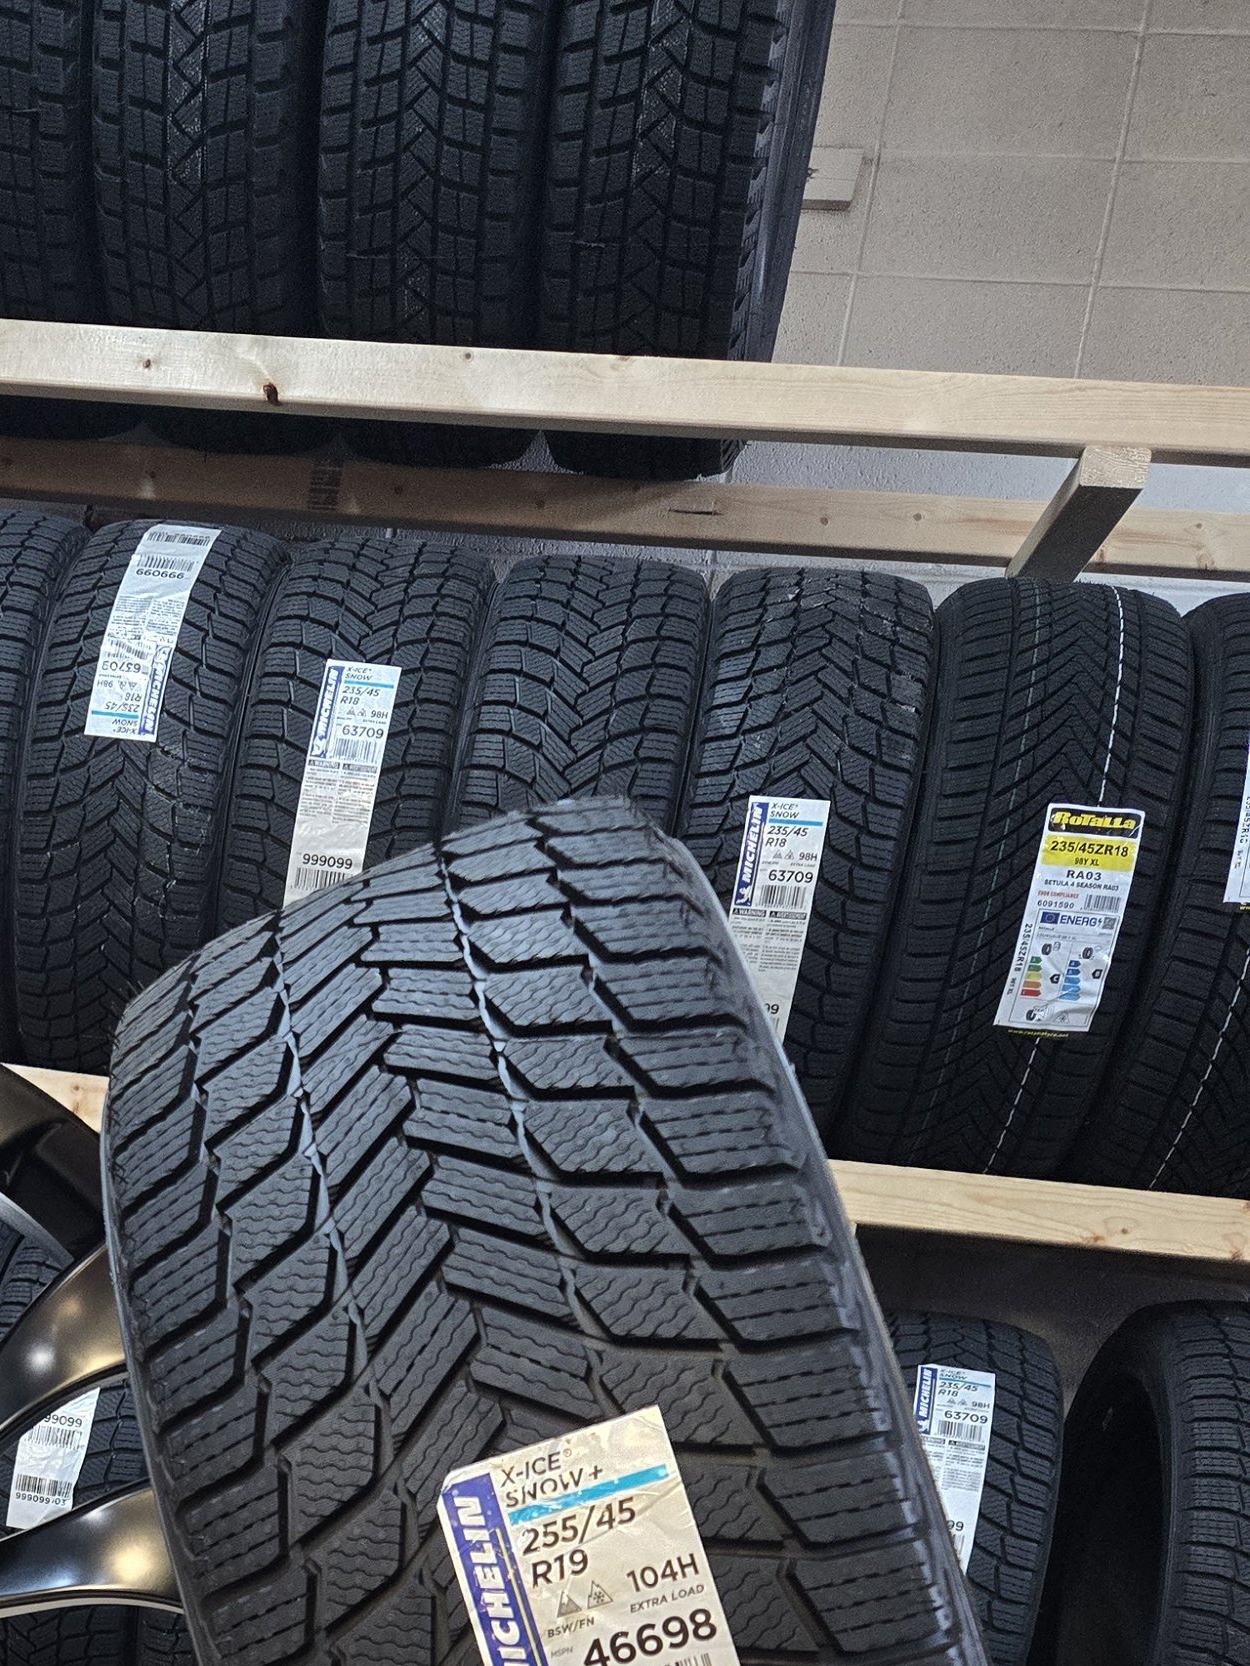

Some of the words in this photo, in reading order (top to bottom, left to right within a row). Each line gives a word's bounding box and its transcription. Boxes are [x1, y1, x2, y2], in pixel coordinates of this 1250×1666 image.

[102, 660, 141, 673] 63709
[345, 673, 373, 681] SNOW
[125, 692, 142, 702] R18
[342, 686, 381, 697] 235/45
[318, 668, 338, 736] MICHELIN
[340, 695, 360, 706] R18
[105, 702, 141, 713] 235/45
[370, 710, 389, 719] 98H
[342, 725, 384, 739] 63709
[769, 811, 799, 819] SNOW
[766, 825, 809, 837] 235/45
[741, 805, 764, 883] MICHELIN
[765, 837, 787, 848] R18
[1050, 840, 1129, 857] 235/45ZR18
[302, 853, 353, 869] 999099
[799, 852, 818, 861] 98H
[768, 870, 813, 884] 63709
[1066, 870, 1102, 880] RA03
[1038, 900, 1074, 909] 6091590
[1059, 915, 1097, 926] ENERG
[938, 1381, 978, 1392] 235/45
[918, 1369, 933, 1417] MICHELIN
[938, 1389, 959, 1397] R18
[44, 1414, 83, 1427] 99099
[944, 1410, 988, 1424] 63709
[506, 1468, 583, 1508] SNOW
[522, 1496, 636, 1557] 255/45
[531, 1549, 588, 1588] R19
[626, 1553, 700, 1593] 104H
[630, 1595, 668, 1614] EXTRA
[670, 1584, 705, 1602] LOAD
